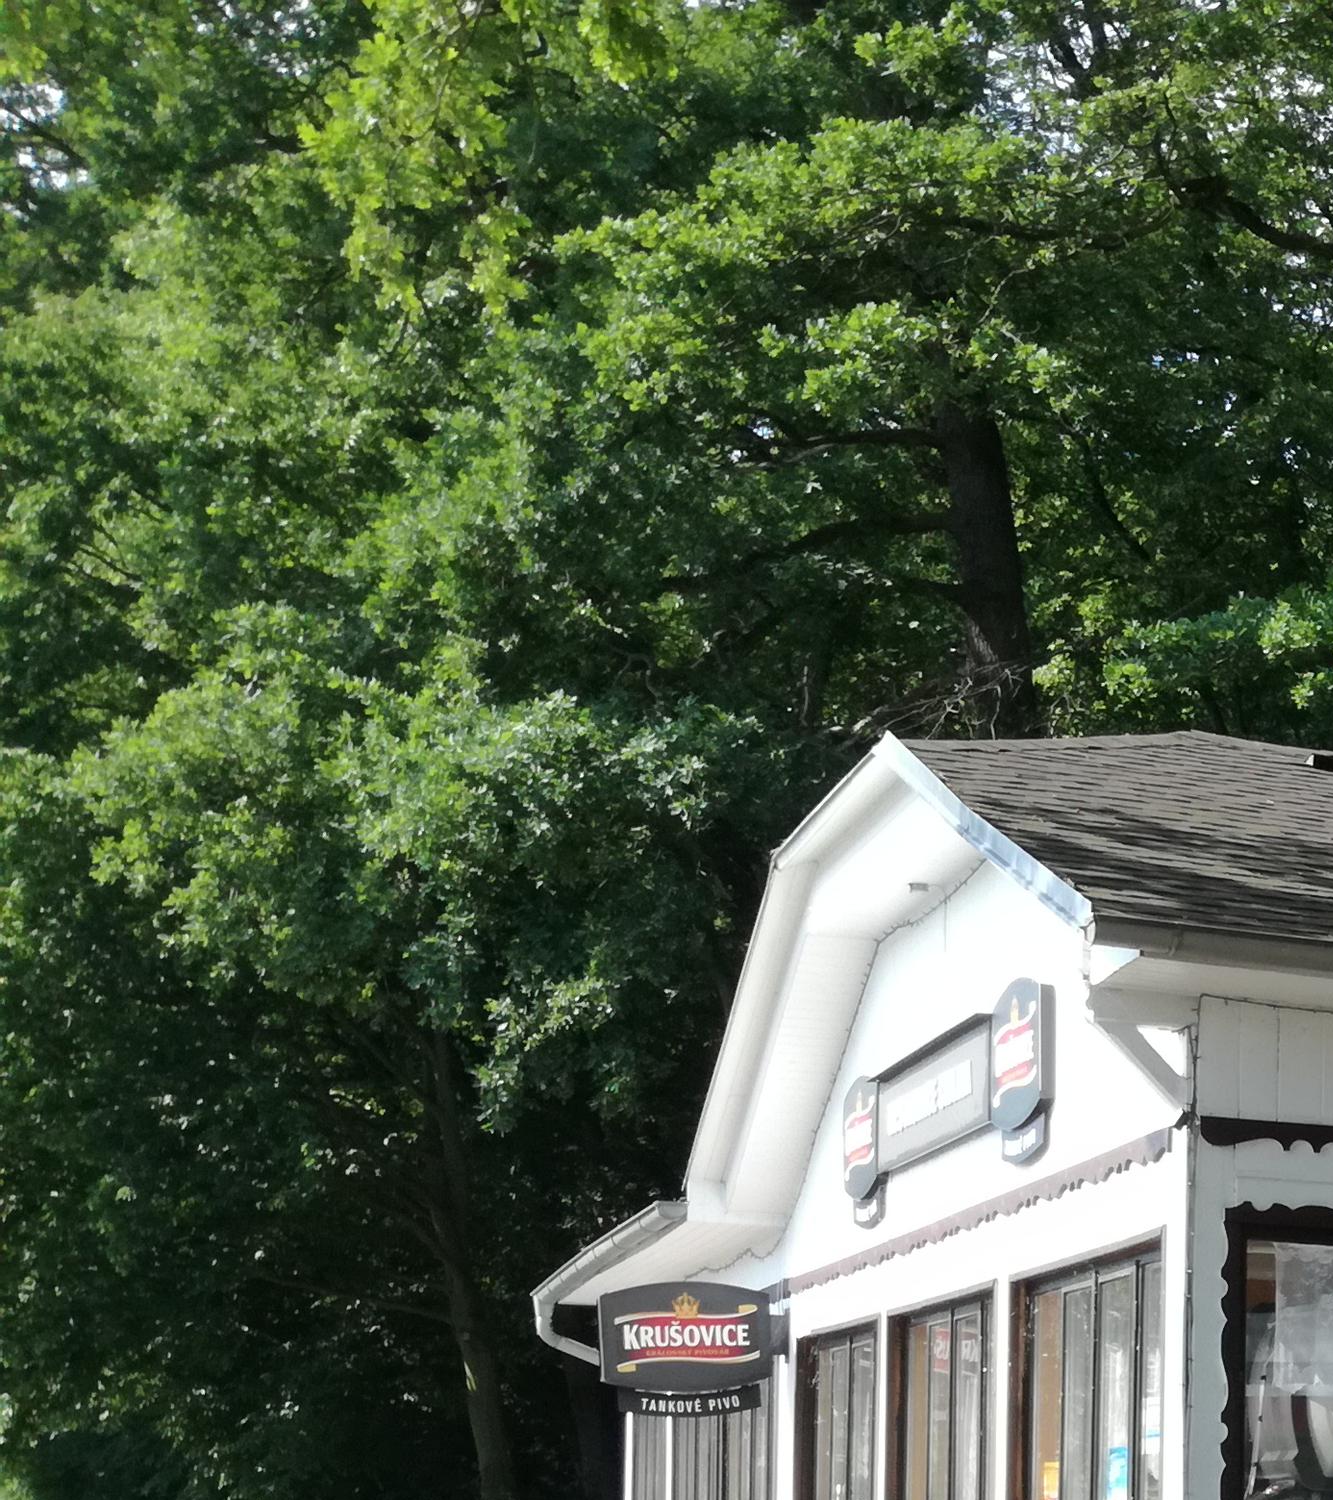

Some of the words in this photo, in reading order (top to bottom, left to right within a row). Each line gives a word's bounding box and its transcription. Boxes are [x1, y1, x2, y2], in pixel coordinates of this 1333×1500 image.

[622, 1320, 751, 1351] KRUŠOVICE
[640, 1397, 703, 1414] TANKOVÉ
[708, 1394, 741, 1411] PIVO
